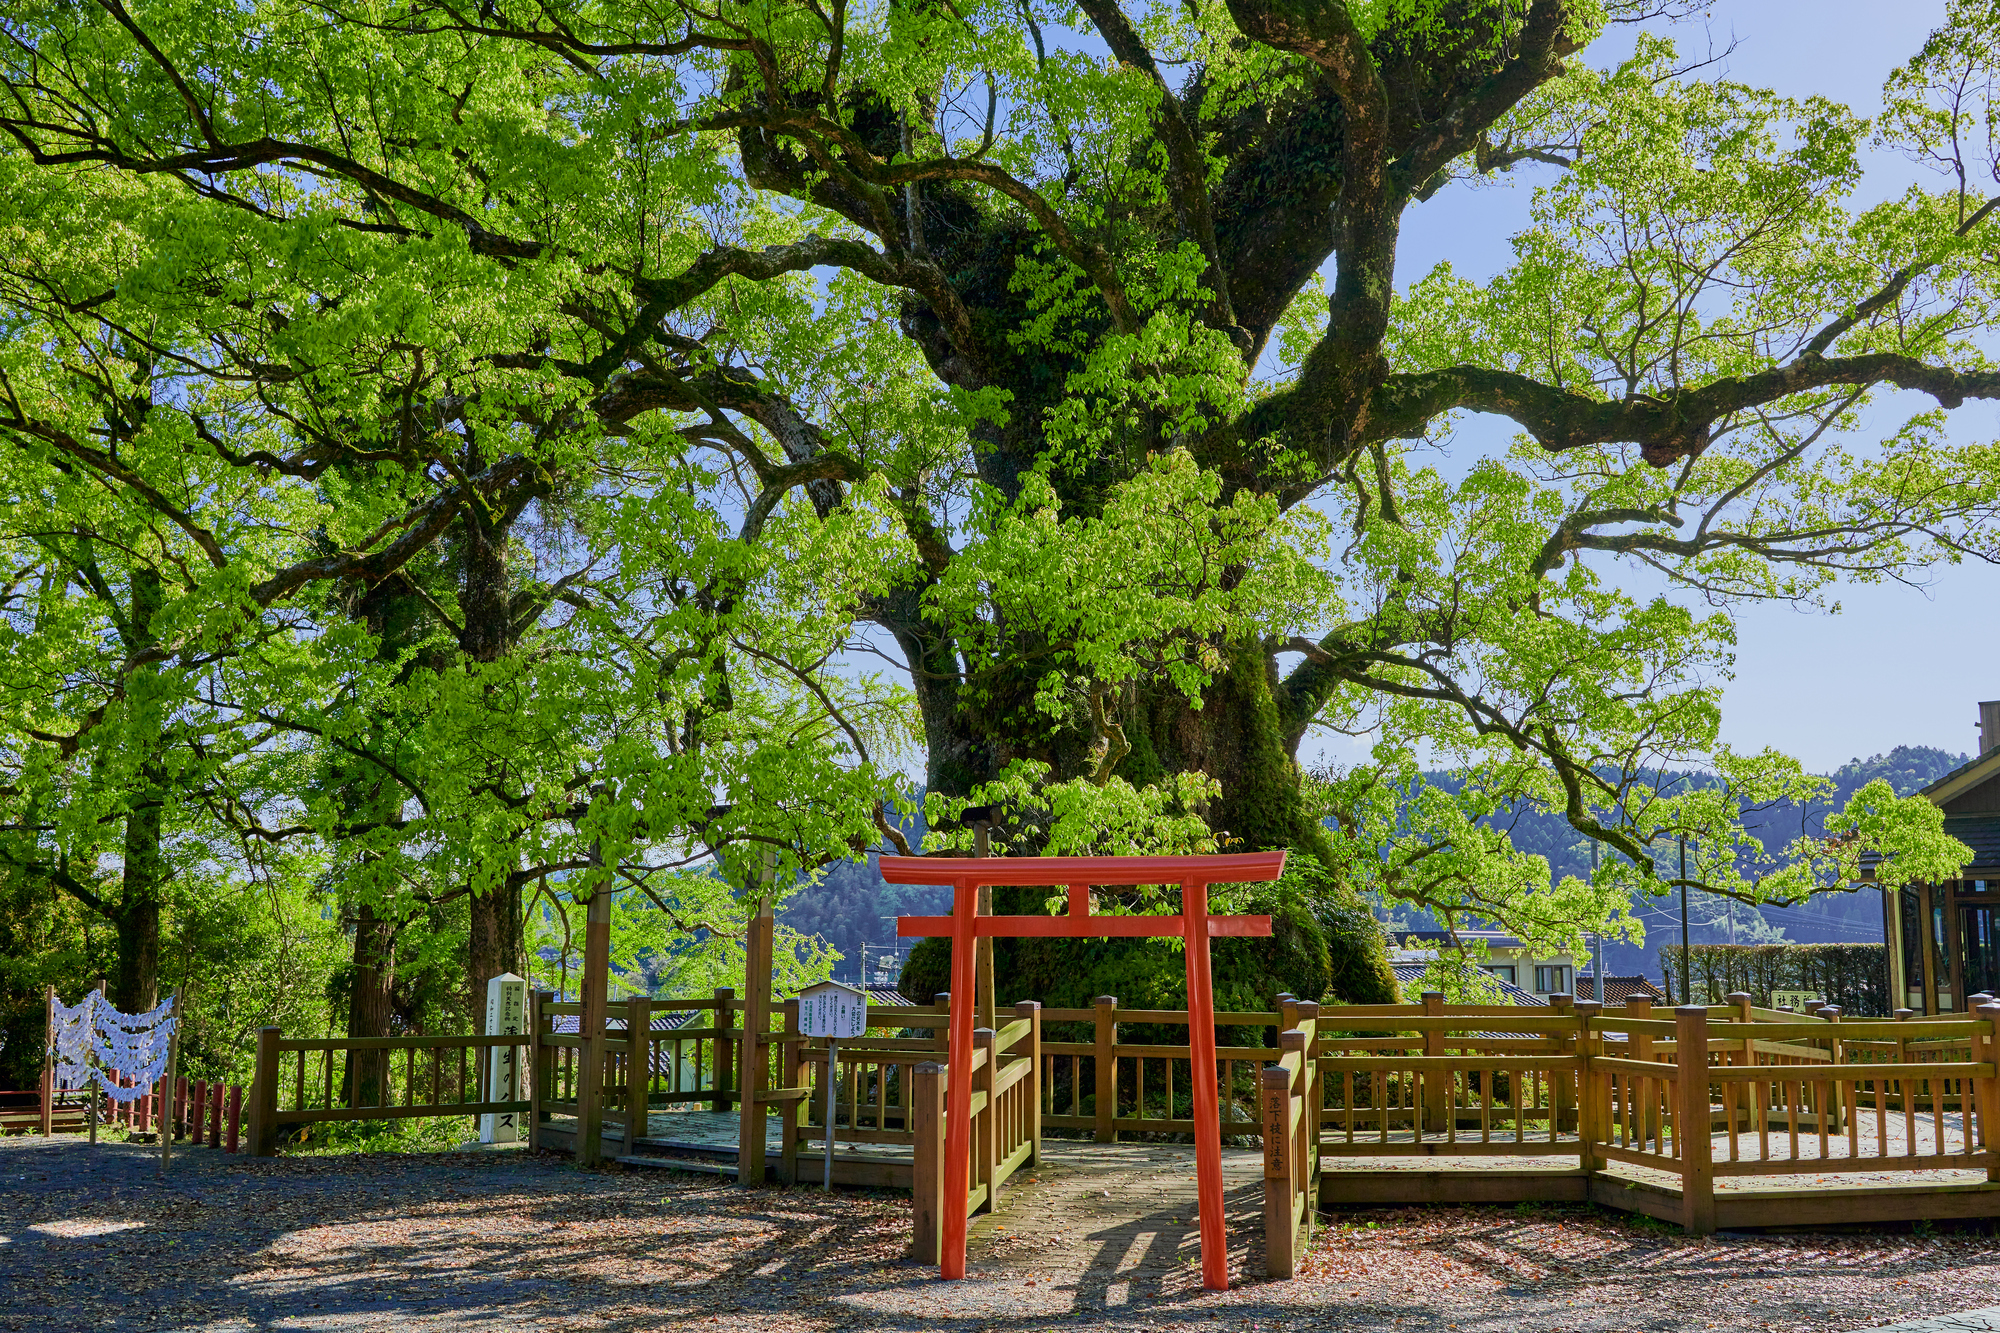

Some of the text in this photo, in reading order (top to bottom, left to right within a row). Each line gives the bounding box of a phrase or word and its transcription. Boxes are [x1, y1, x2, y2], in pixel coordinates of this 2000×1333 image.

[1269, 1096, 1283, 1171] 落下枝に注意
